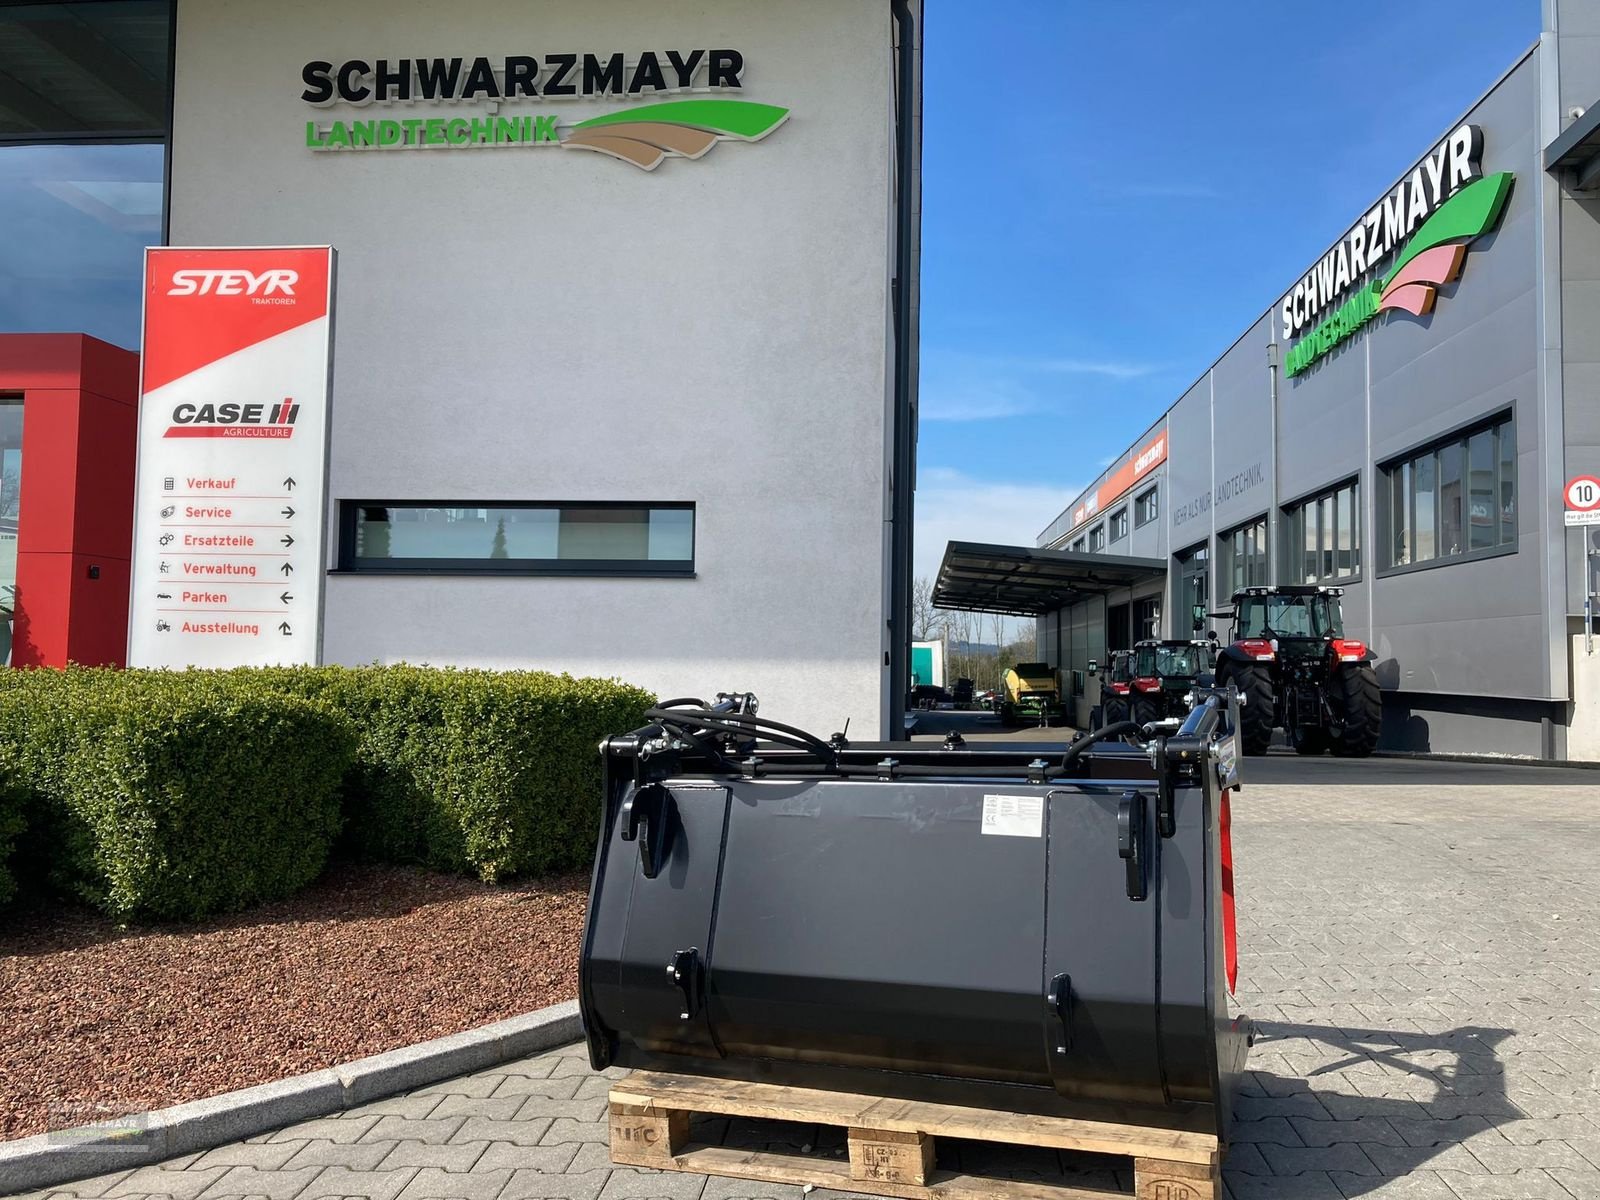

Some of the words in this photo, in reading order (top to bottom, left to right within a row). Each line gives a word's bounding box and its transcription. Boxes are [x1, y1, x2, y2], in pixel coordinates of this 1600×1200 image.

[301, 49, 744, 103] SCHWARZMAYR
[306, 115, 560, 148] LANDTECHNIK
[1282, 124, 1474, 340] SCHWARZMAYR
[167, 269, 299, 296] STEYR
[172, 403, 264, 424] CASE
[223, 428, 289, 437] AGRICULTURE
[187, 478, 236, 489] Verkauf
[1576, 485, 1592, 502] 10
[185, 507, 232, 518] Service
[184, 535, 255, 546] Ersatzteile
[183, 563, 257, 577] Verwaltung
[182, 592, 227, 603] Parken
[181, 622, 259, 635] Ausstellung
